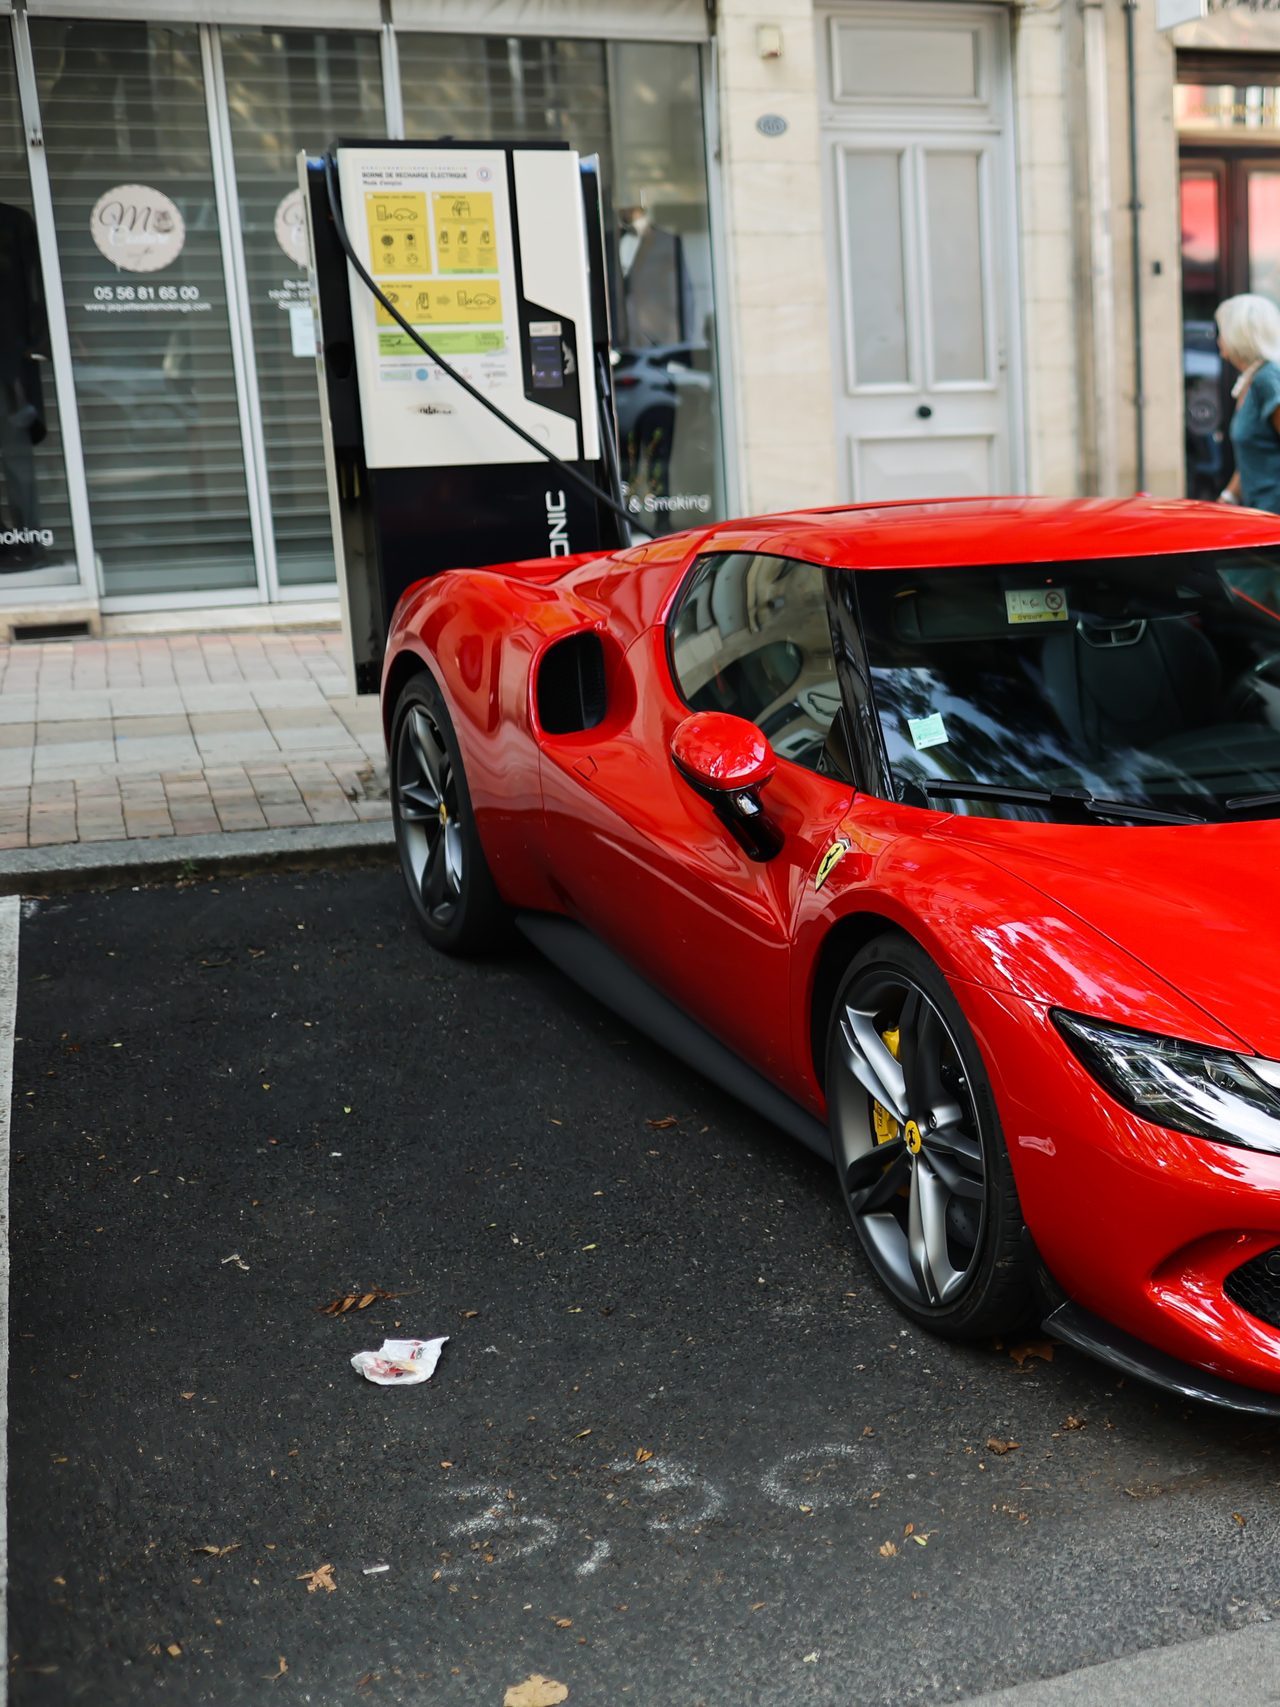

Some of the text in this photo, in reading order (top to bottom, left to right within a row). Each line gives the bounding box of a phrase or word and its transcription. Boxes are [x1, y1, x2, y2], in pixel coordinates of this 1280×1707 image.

[93, 286, 200, 300] 05 56 81 65 00
[628, 493, 711, 514] & Smoking
[0, 527, 54, 546] oking
